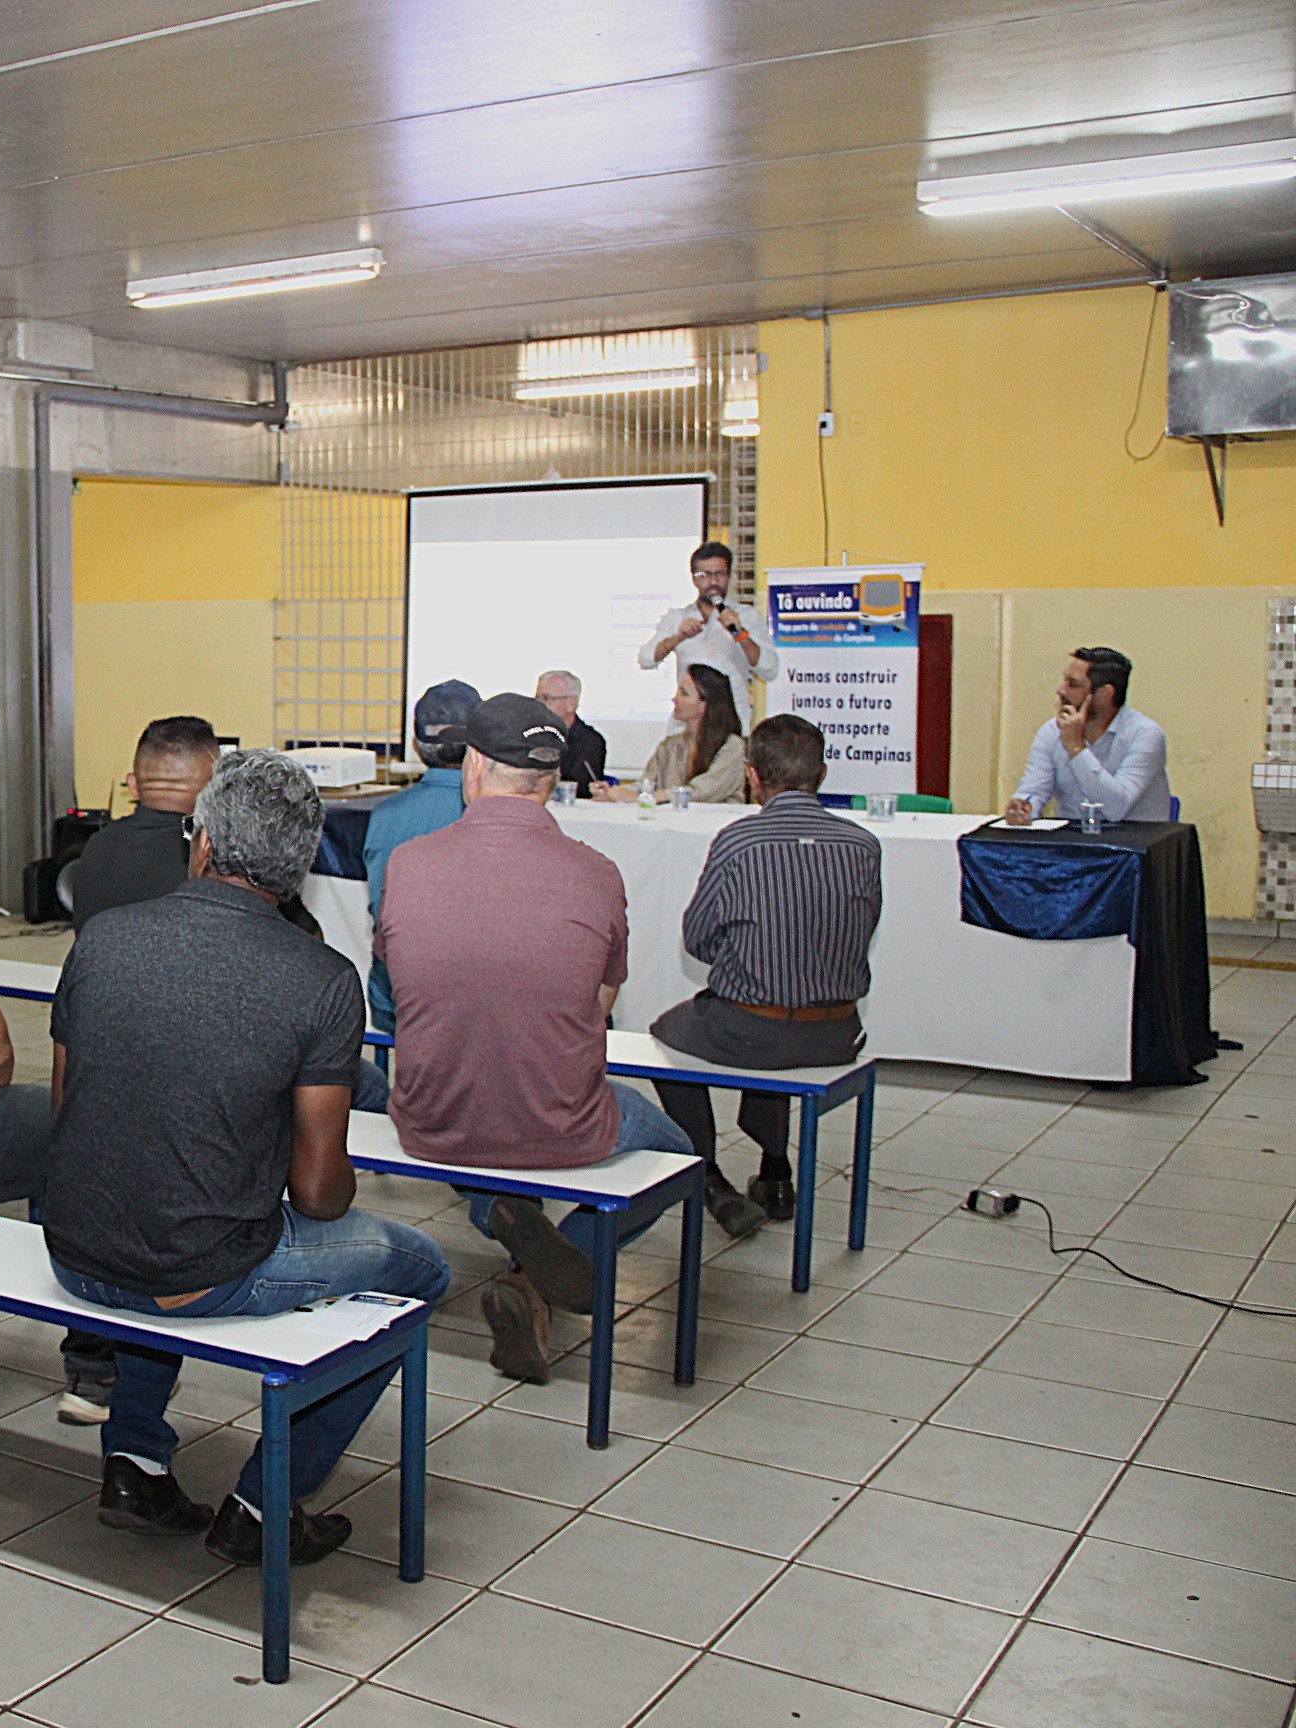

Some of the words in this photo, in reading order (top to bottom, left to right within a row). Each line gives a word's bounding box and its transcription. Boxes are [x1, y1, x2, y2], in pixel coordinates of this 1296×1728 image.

[777, 592, 794, 610] Tô
[795, 591, 853, 610] ouvindo
[787, 668, 830, 683] Vamos
[835, 669, 898, 683] construir
[792, 693, 831, 711] juntos
[836, 698, 844, 709] o
[848, 694, 892, 710] futuro
[817, 720, 890, 738] transporte
[825, 744, 840, 760] de
[845, 745, 912, 764] Campinas
